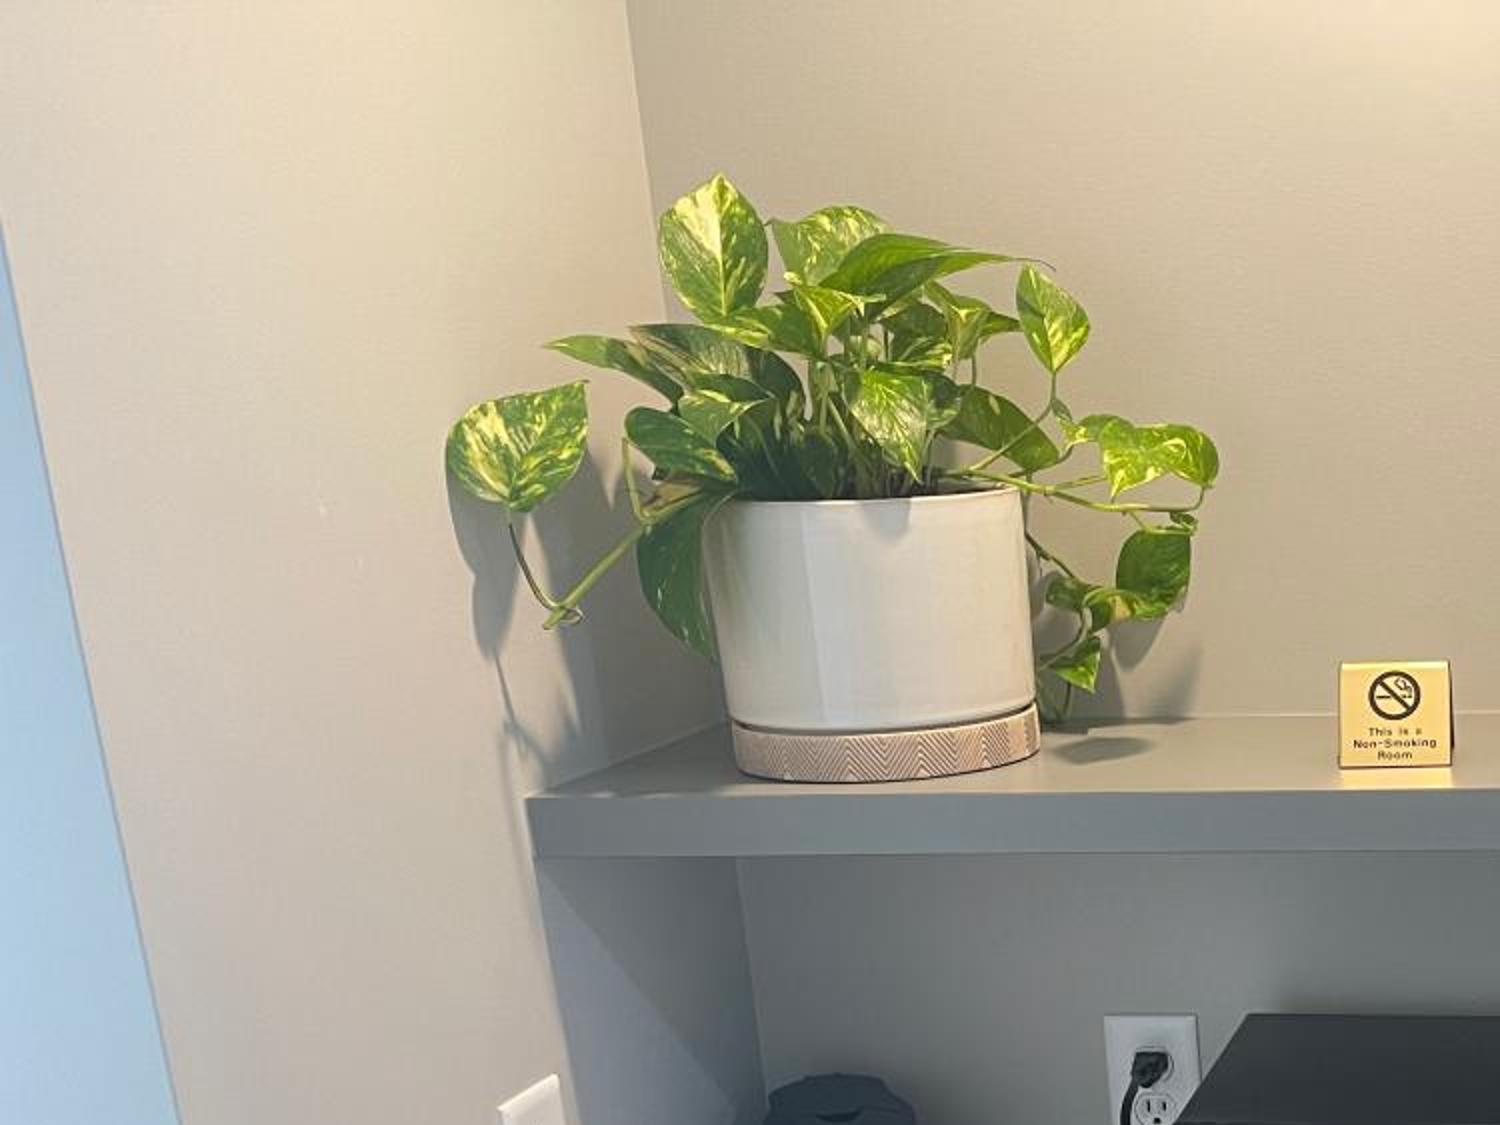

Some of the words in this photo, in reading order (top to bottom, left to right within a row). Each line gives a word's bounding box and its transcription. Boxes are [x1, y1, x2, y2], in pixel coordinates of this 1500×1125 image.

[1368, 727, 1393, 737] This
[1353, 739, 1437, 749] Non-Smoking
[1377, 751, 1413, 760] Room
